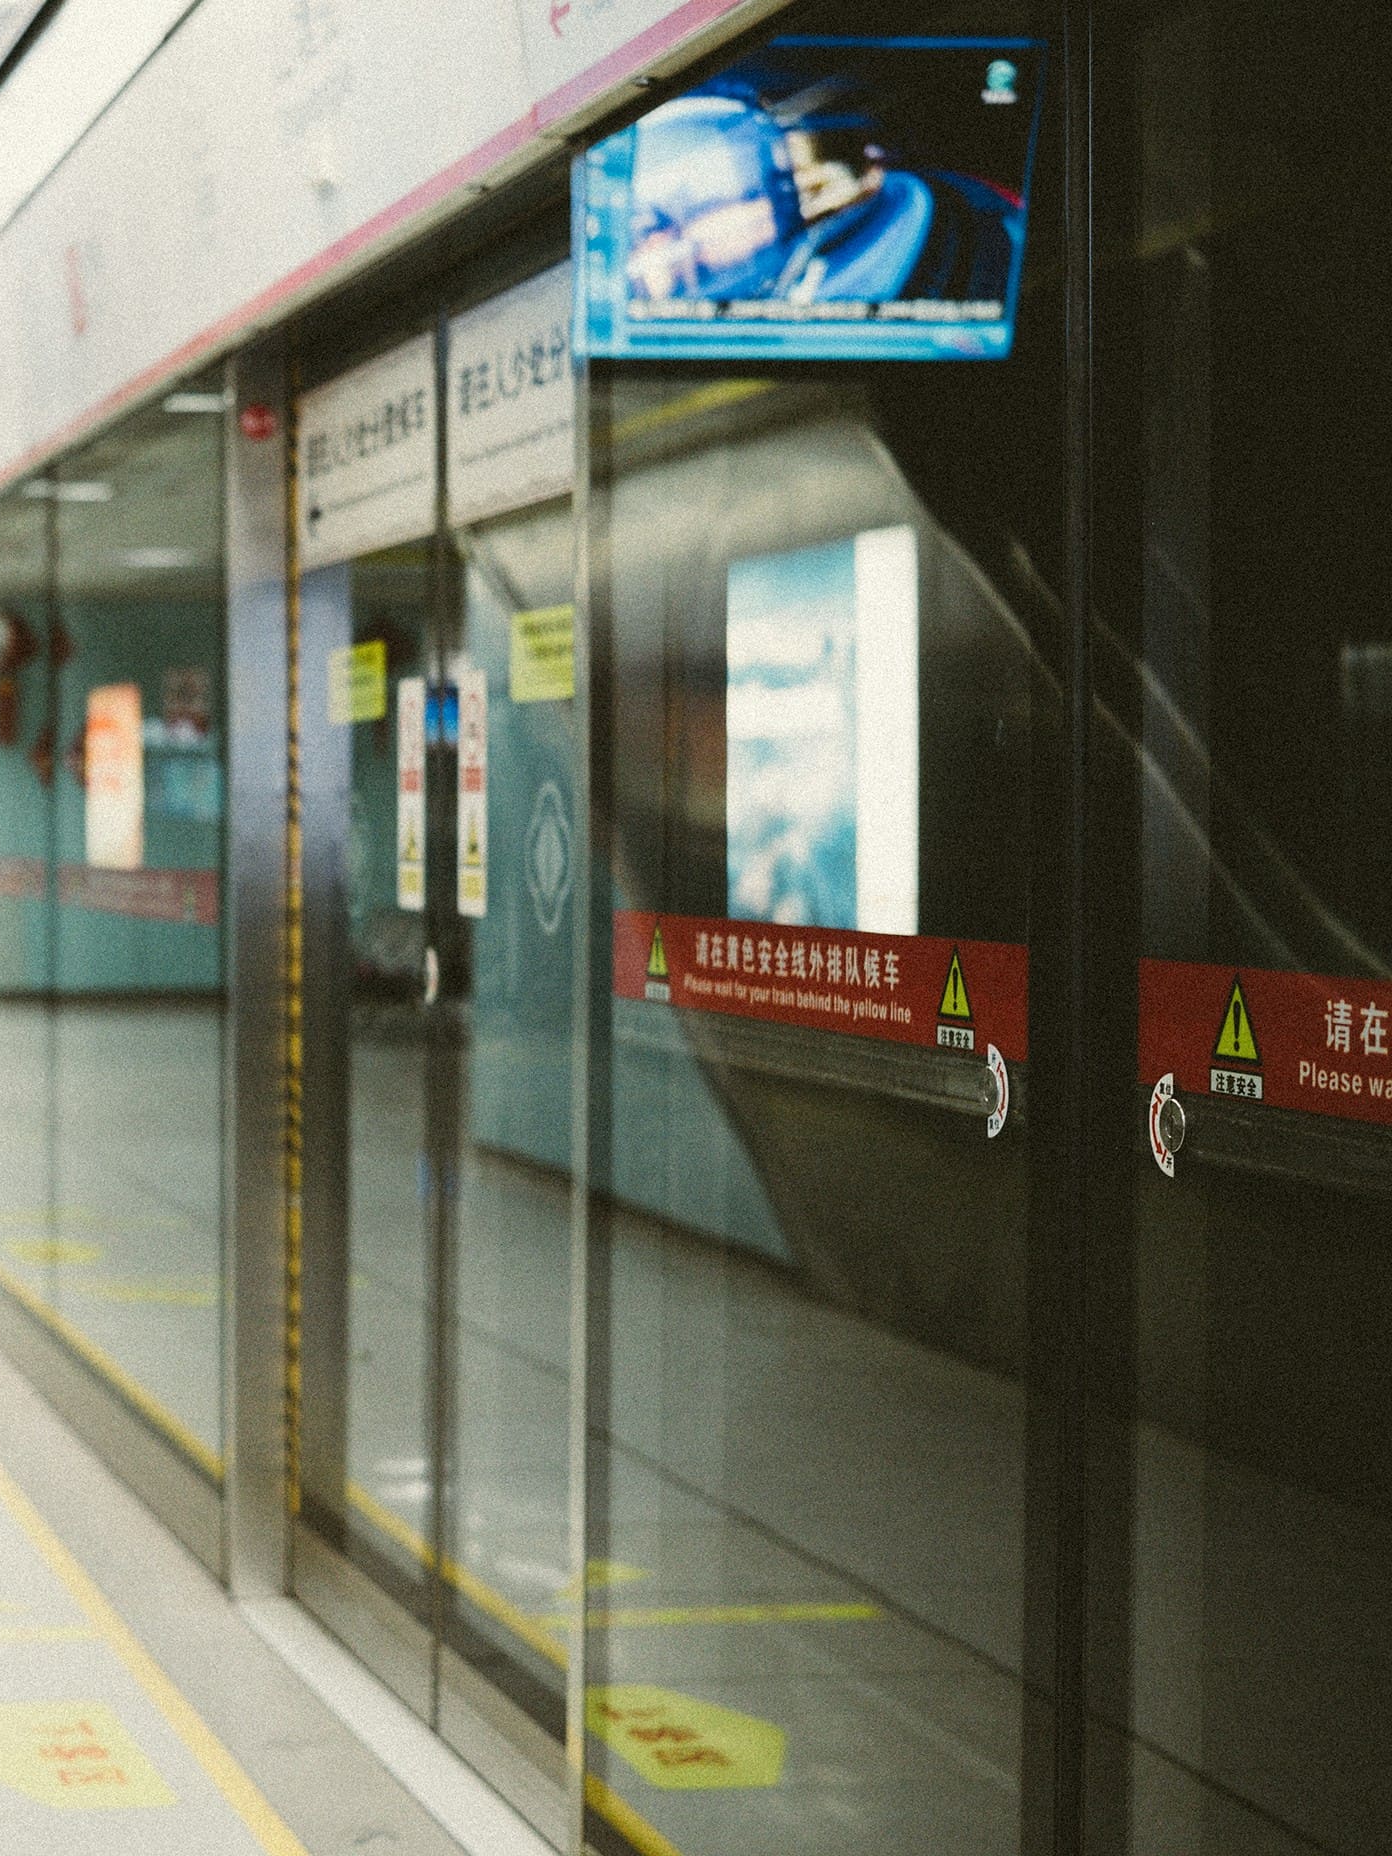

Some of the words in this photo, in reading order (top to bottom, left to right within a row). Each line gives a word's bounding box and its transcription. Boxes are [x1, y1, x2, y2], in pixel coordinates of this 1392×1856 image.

[696, 932, 900, 991] 请在黄色安全线外排队候车
[749, 986, 769, 1003] your
[772, 986, 795, 1005] train
[797, 989, 831, 1012] behind
[834, 994, 849, 1014] the
[853, 997, 887, 1021] yellow
[890, 1001, 911, 1024] line
[940, 1029, 970, 1047] 注意安全
[1324, 1000, 1389, 1055] 请在
[1215, 1073, 1256, 1097] 注意安全
[1300, 1061, 1362, 1094] Please
